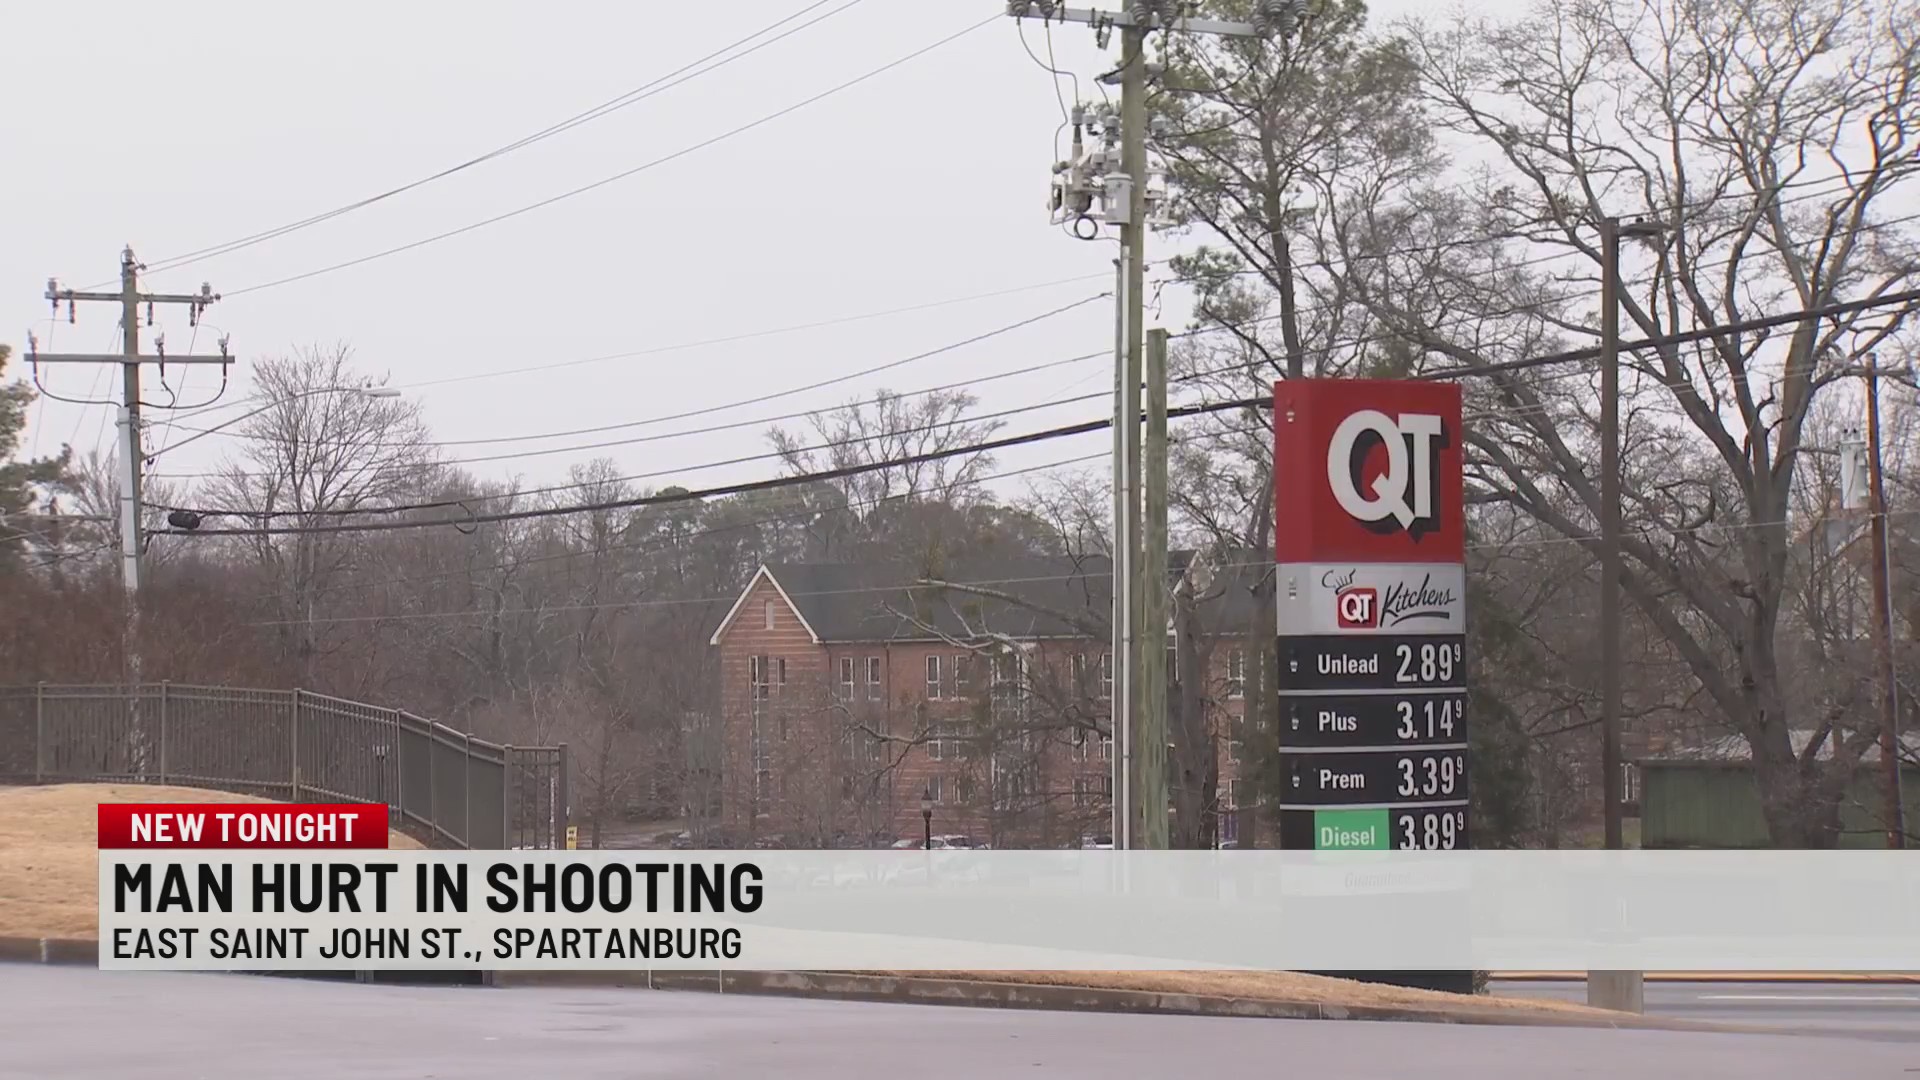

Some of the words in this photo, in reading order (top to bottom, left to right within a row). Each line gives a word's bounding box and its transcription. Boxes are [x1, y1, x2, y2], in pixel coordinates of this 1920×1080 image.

[1328, 409, 1442, 530] QT
[1341, 593, 1373, 622] QT
[1380, 572, 1456, 628] Kitchens
[1318, 654, 1378, 674] Unlead
[1319, 711, 1357, 731] Plus
[1320, 769, 1365, 788] Prem
[1321, 826, 1375, 847] Diesel
